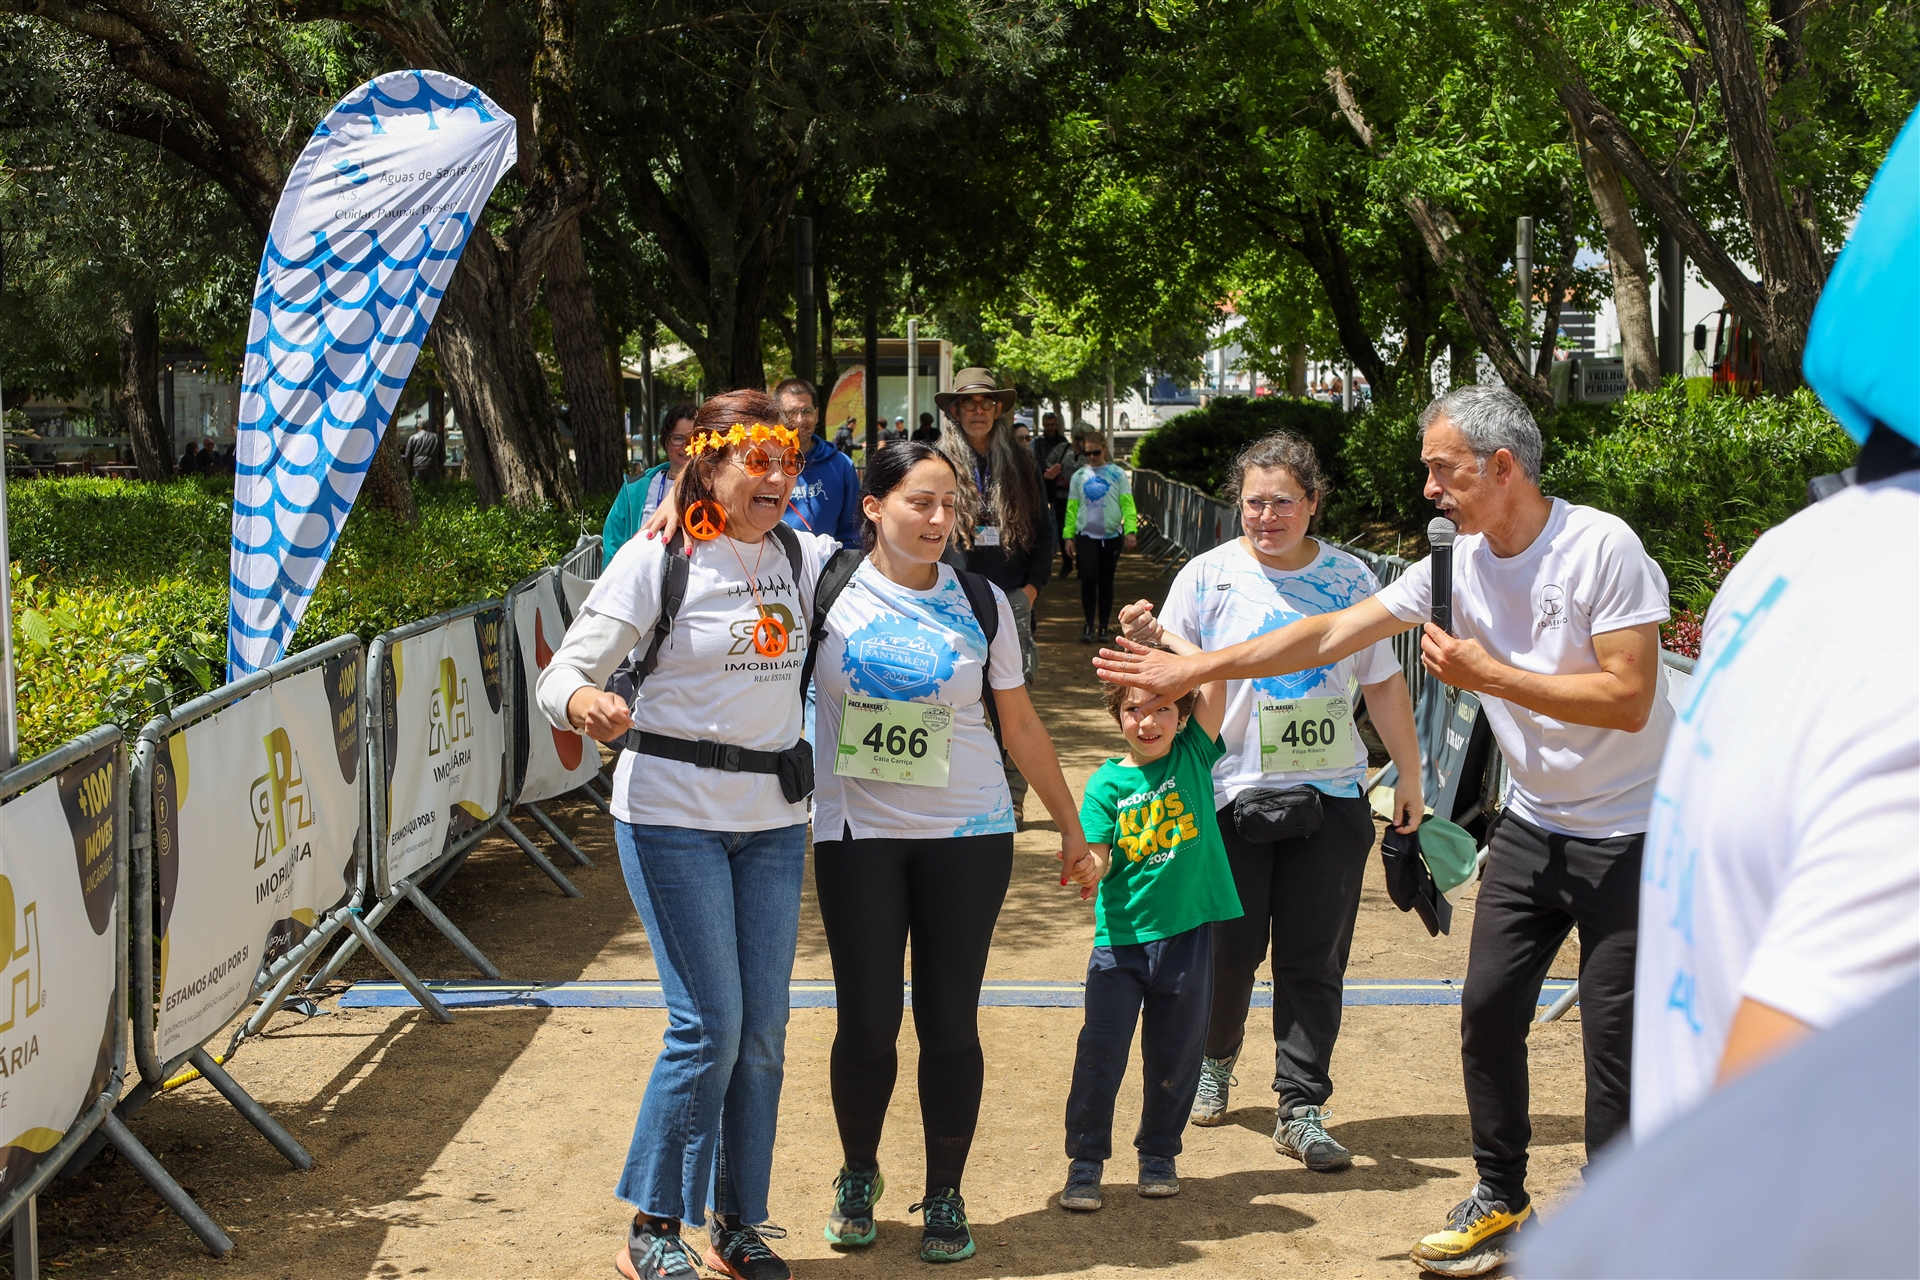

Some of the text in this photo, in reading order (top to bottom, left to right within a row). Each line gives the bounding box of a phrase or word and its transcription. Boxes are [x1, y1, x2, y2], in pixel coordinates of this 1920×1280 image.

[380, 170, 414, 186] Águas
[419, 169, 432, 180] de
[335, 209, 375, 220] Cuidar.
[378, 207, 419, 220] Poupar.
[1588, 371, 1623, 380] TRILHO
[1585, 384, 1626, 393] PERDIDO
[865, 648, 930, 668] SANTARÉM
[771, 673, 792, 682] ESTATE
[882, 670, 909, 683] 2026
[1281, 717, 1335, 747] 460
[862, 722, 929, 758] 466
[873, 755, 913, 766] Cátia Carriço
[78, 762, 113, 818] +1000
[417, 813, 431, 828] POR
[1119, 793, 1184, 836] KIDS
[1149, 850, 1175, 865] 2024
[166, 944, 249, 1013] ESTAMOS AQUI POR SI
